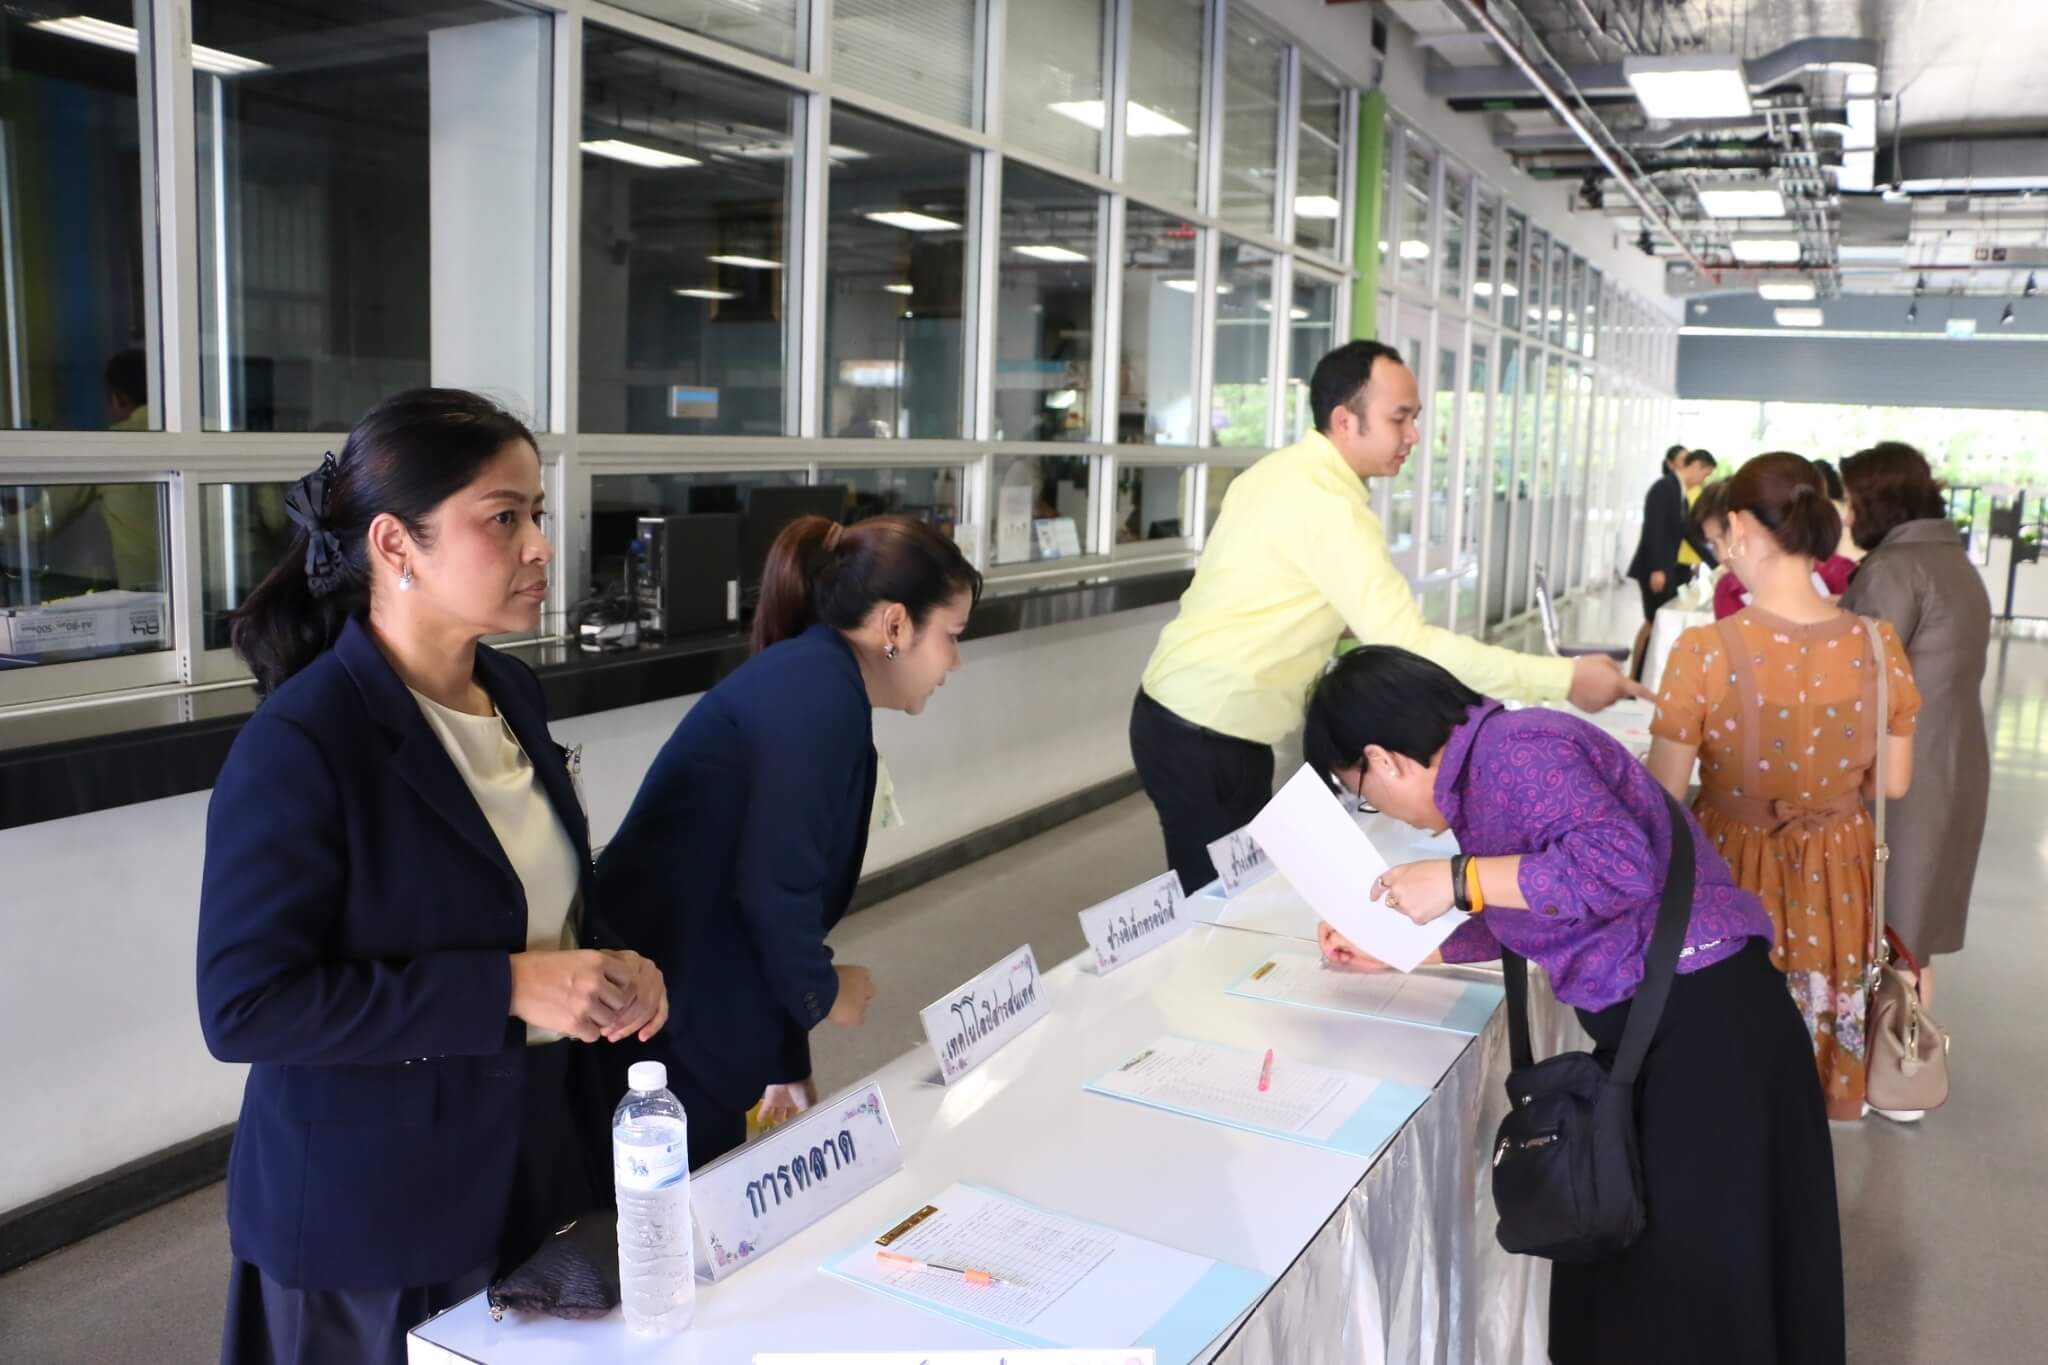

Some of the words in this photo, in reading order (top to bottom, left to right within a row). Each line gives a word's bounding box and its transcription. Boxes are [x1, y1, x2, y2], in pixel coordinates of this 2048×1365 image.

[945, 965, 1036, 1060] เทคโนโลยีสารสนเทศ
[746, 1129, 856, 1218] การตลาด
